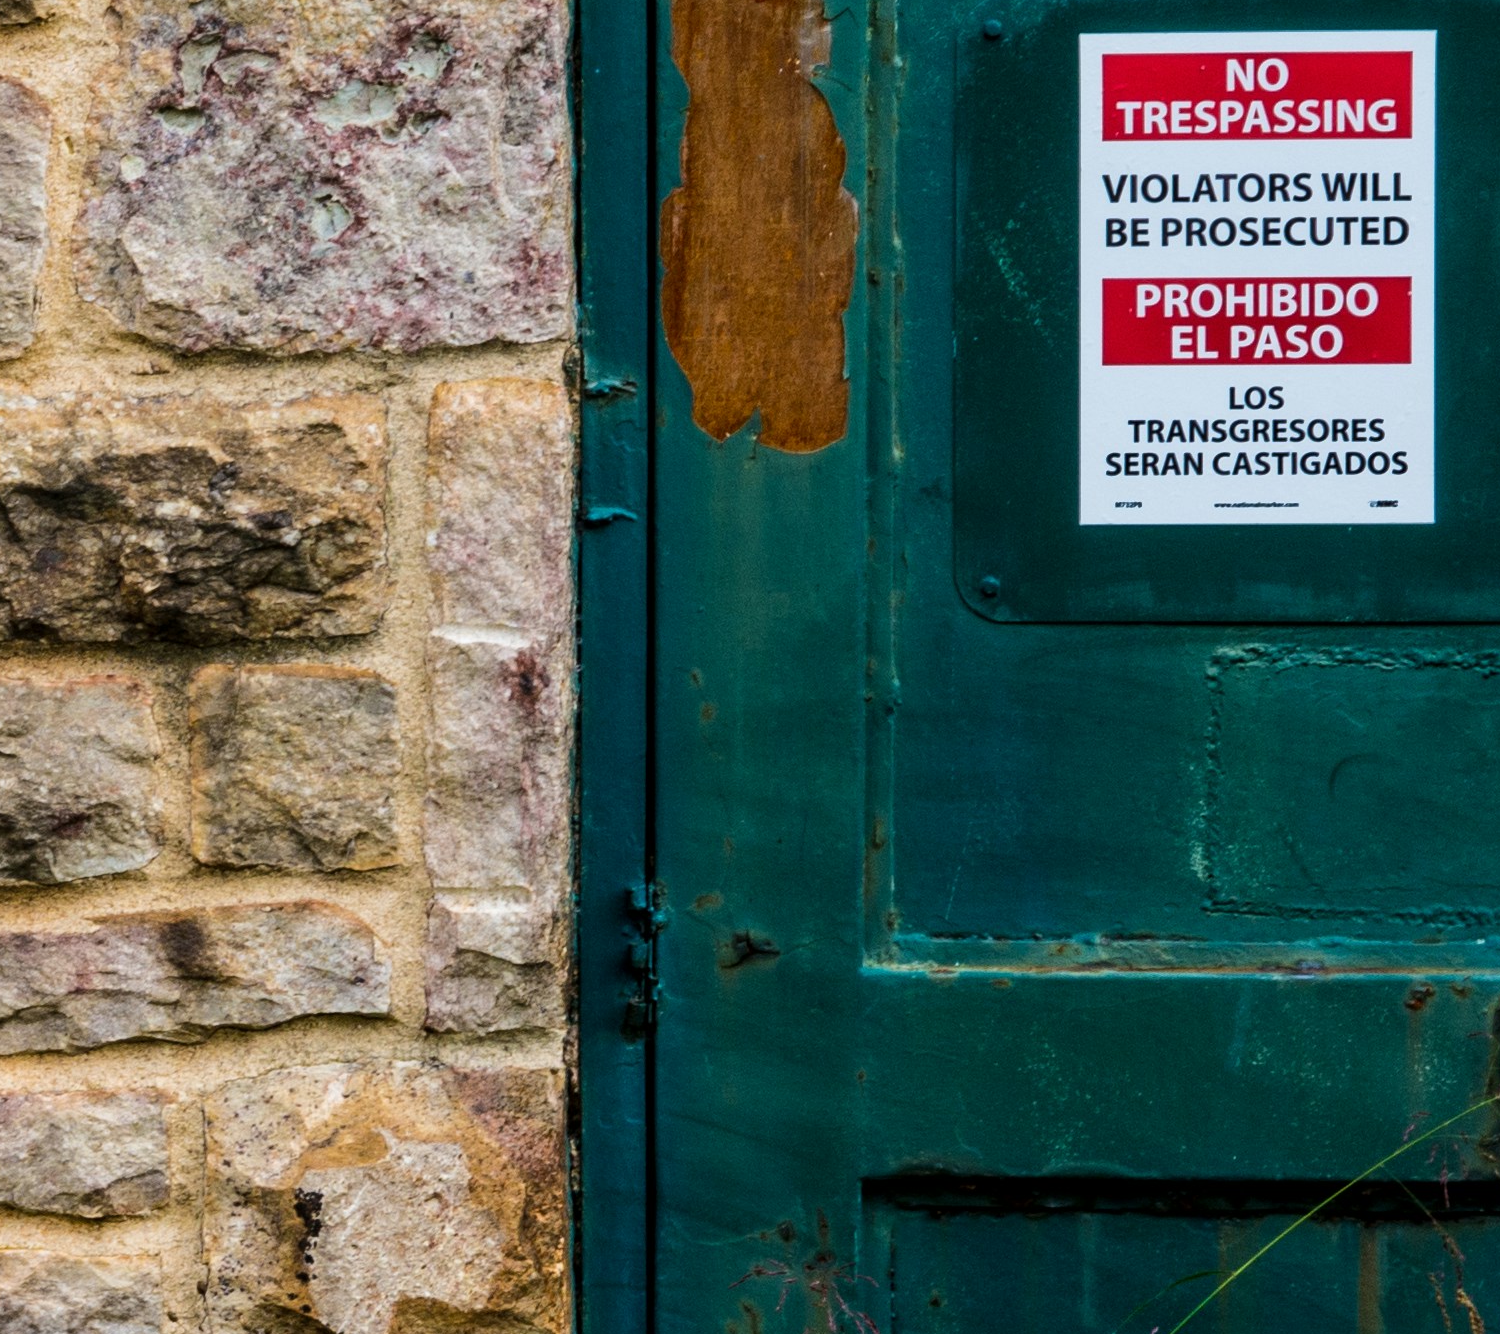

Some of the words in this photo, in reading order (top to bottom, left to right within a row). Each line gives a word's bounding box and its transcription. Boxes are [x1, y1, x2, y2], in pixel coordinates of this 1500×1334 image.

[1226, 58, 1290, 92] NO
[1116, 99, 1398, 135] TRESPASSING
[1102, 172, 1313, 204] VIOLATORS
[1321, 172, 1413, 202] WILL
[1104, 218, 1150, 248] BE
[1160, 216, 1410, 247] PROSECUTED
[1135, 282, 1379, 318] PROHIBIDO
[1170, 325, 1219, 359] EL
[1230, 324, 1344, 359] PASO
[1228, 386, 1285, 410] LOS
[1127, 418, 1385, 443] TRANSGRESORES
[1104, 452, 1204, 477] SERAN
[1212, 451, 1409, 476] CASTIGADOS
